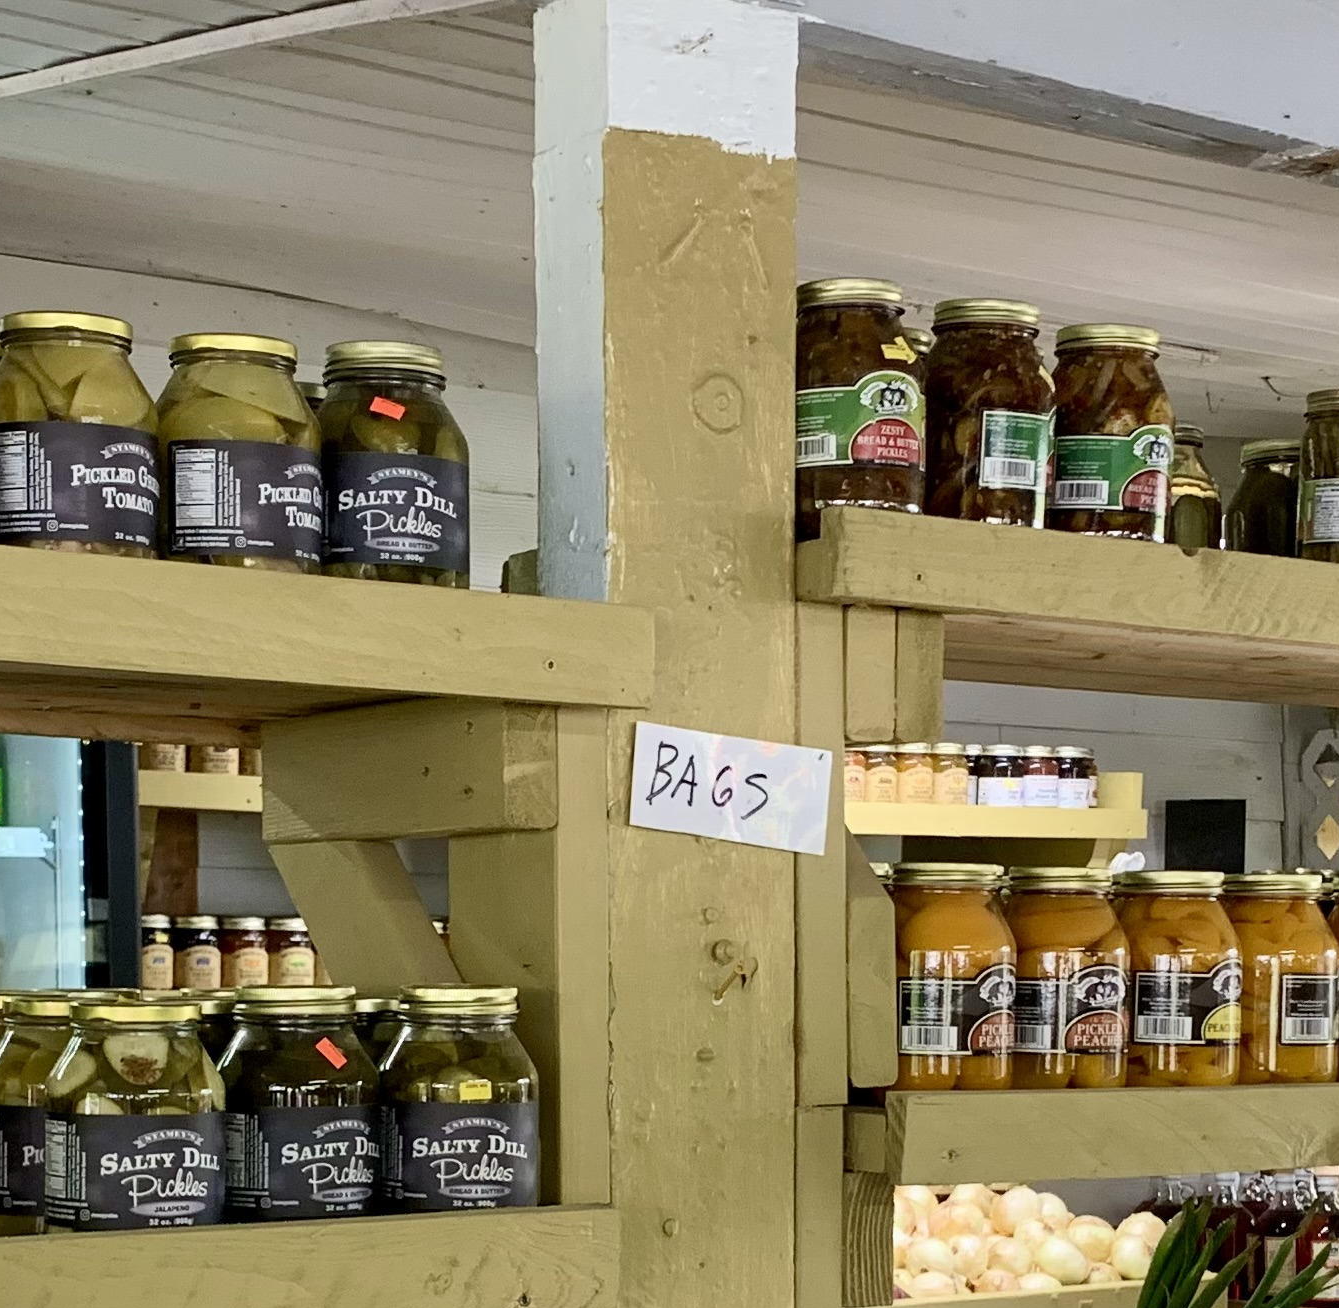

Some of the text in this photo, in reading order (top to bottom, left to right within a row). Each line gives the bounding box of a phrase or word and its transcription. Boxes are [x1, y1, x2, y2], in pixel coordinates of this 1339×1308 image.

[857, 435, 887, 445] BREAD
[880, 425, 906, 435] ZESTY
[877, 446, 908, 458] PICKLES
[70, 464, 136, 487] PICKLED
[102, 486, 154, 515] TOMATO
[258, 483, 311, 505] PICKLED
[338, 486, 457, 519] SALTY DILL
[356, 507, 442, 541] Pickles
[646, 741, 769, 820] BAGS
[281, 1142, 349, 1165] SALTY
[412, 1134, 528, 1159] SALTY DILL
[100, 1147, 220, 1176] SALTY DILL
[301, 1156, 374, 1195] Pickles
[429, 1154, 515, 1189] Pickles
[121, 1168, 208, 1207] Pickles
